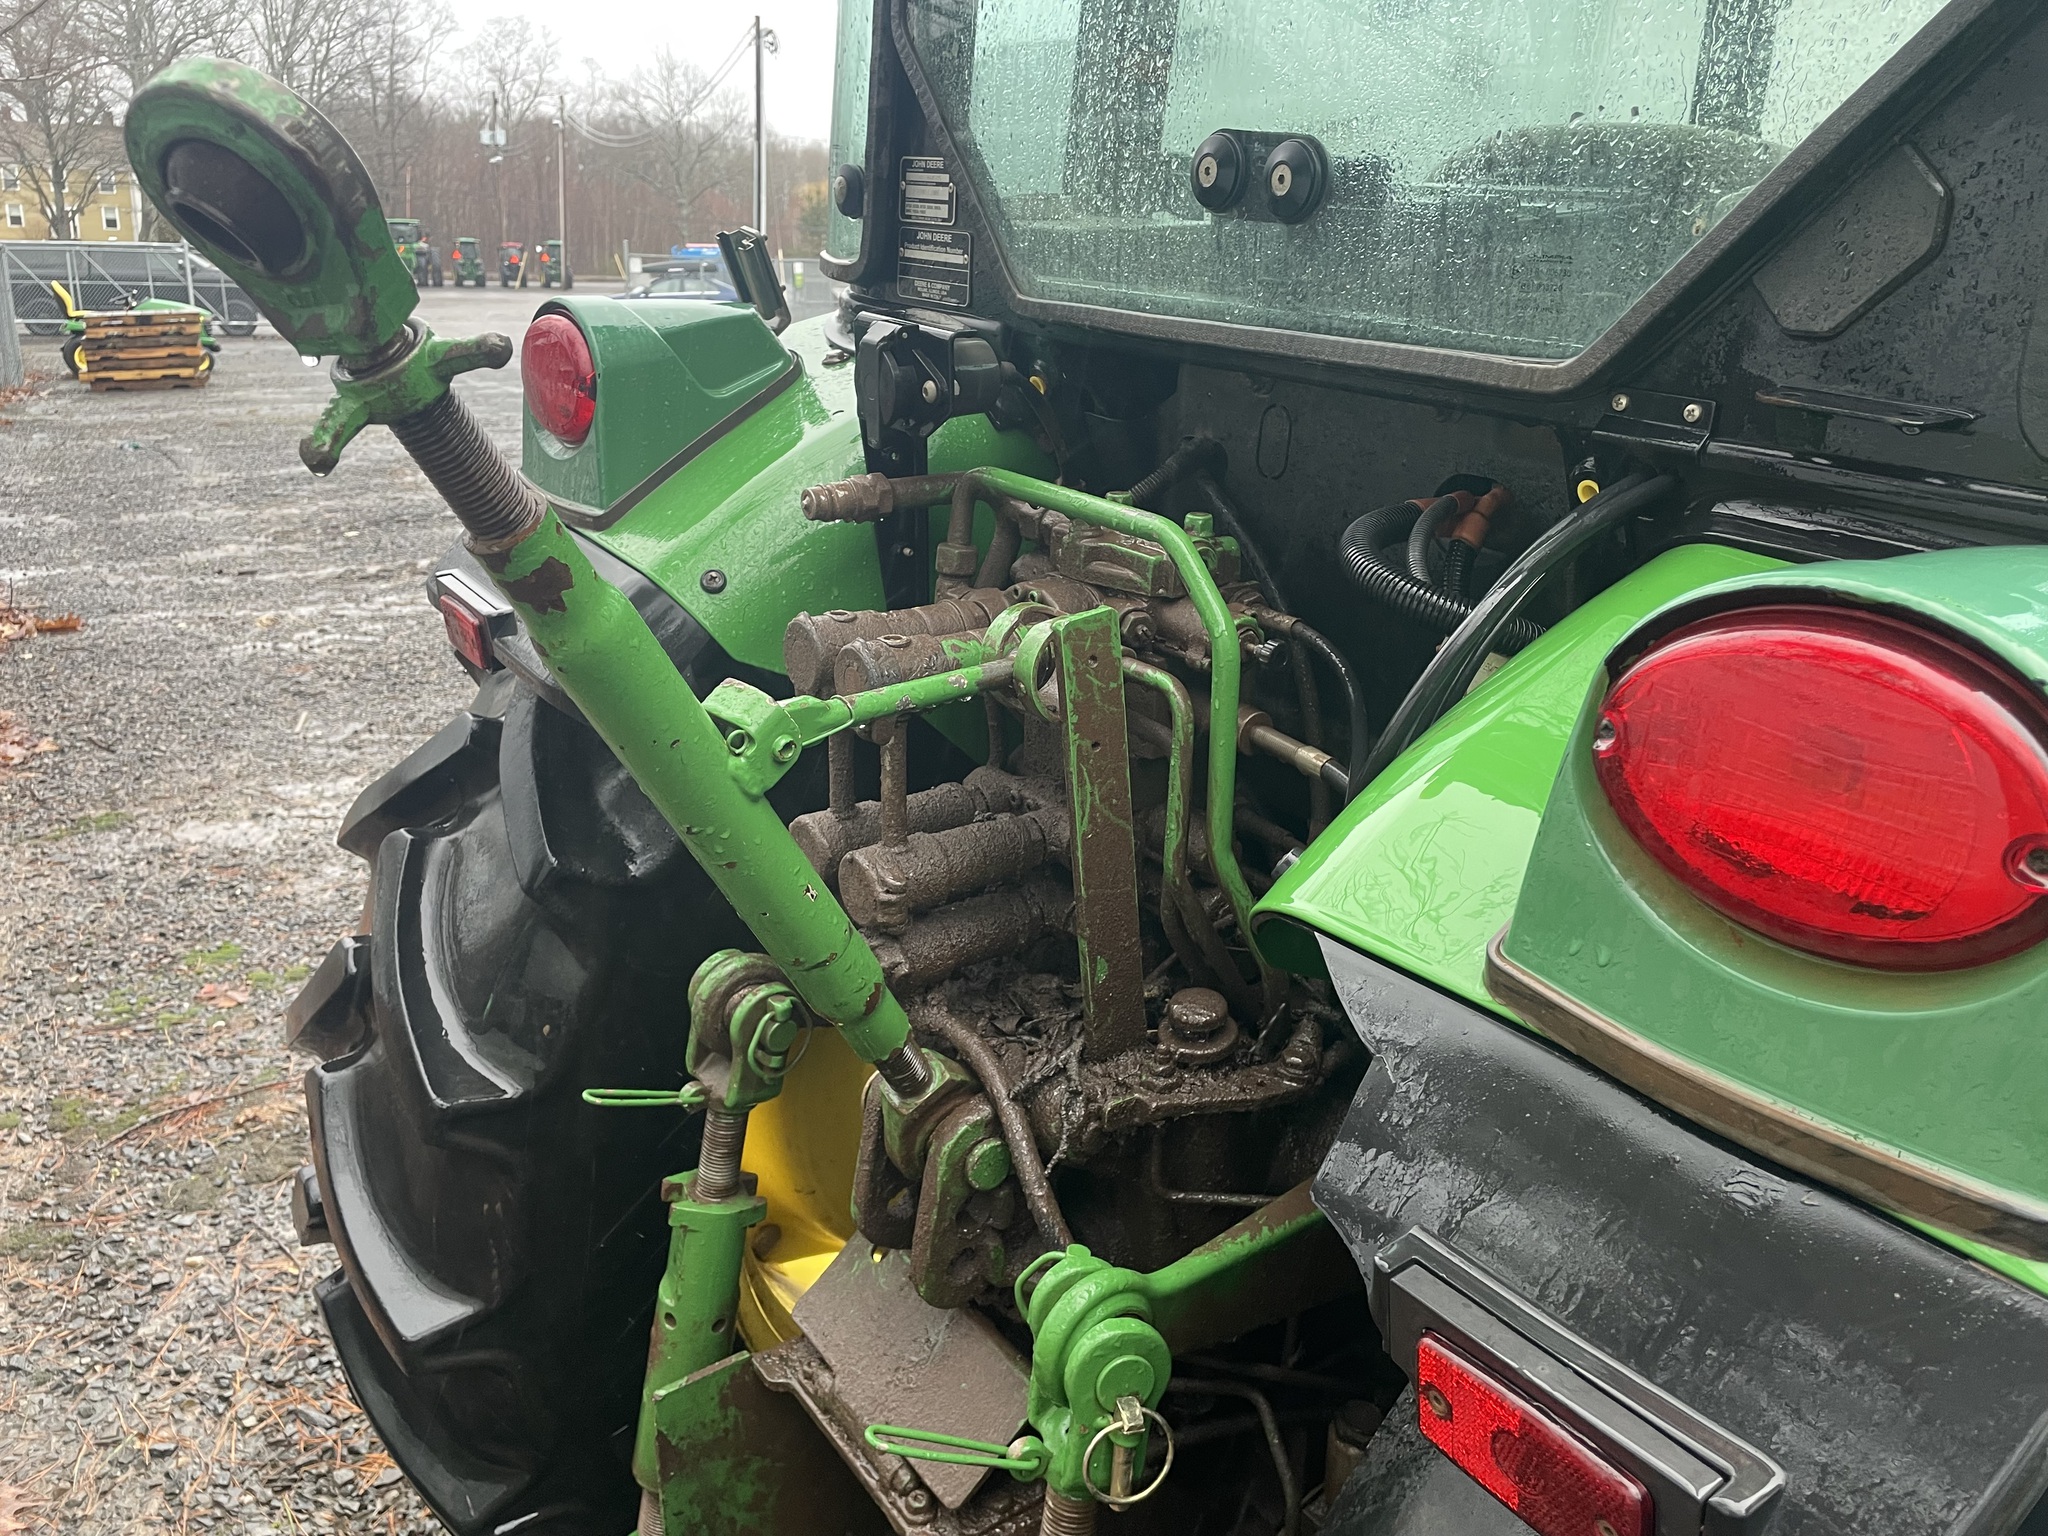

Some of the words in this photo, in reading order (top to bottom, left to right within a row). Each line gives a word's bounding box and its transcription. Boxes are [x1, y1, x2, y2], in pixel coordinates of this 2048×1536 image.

[912, 160, 926, 168] JOHN
[926, 160, 944, 169] DEERE
[917, 232, 932, 240] JOHN
[933, 233, 952, 242] DEERE
[920, 243, 946, 252] Identification
